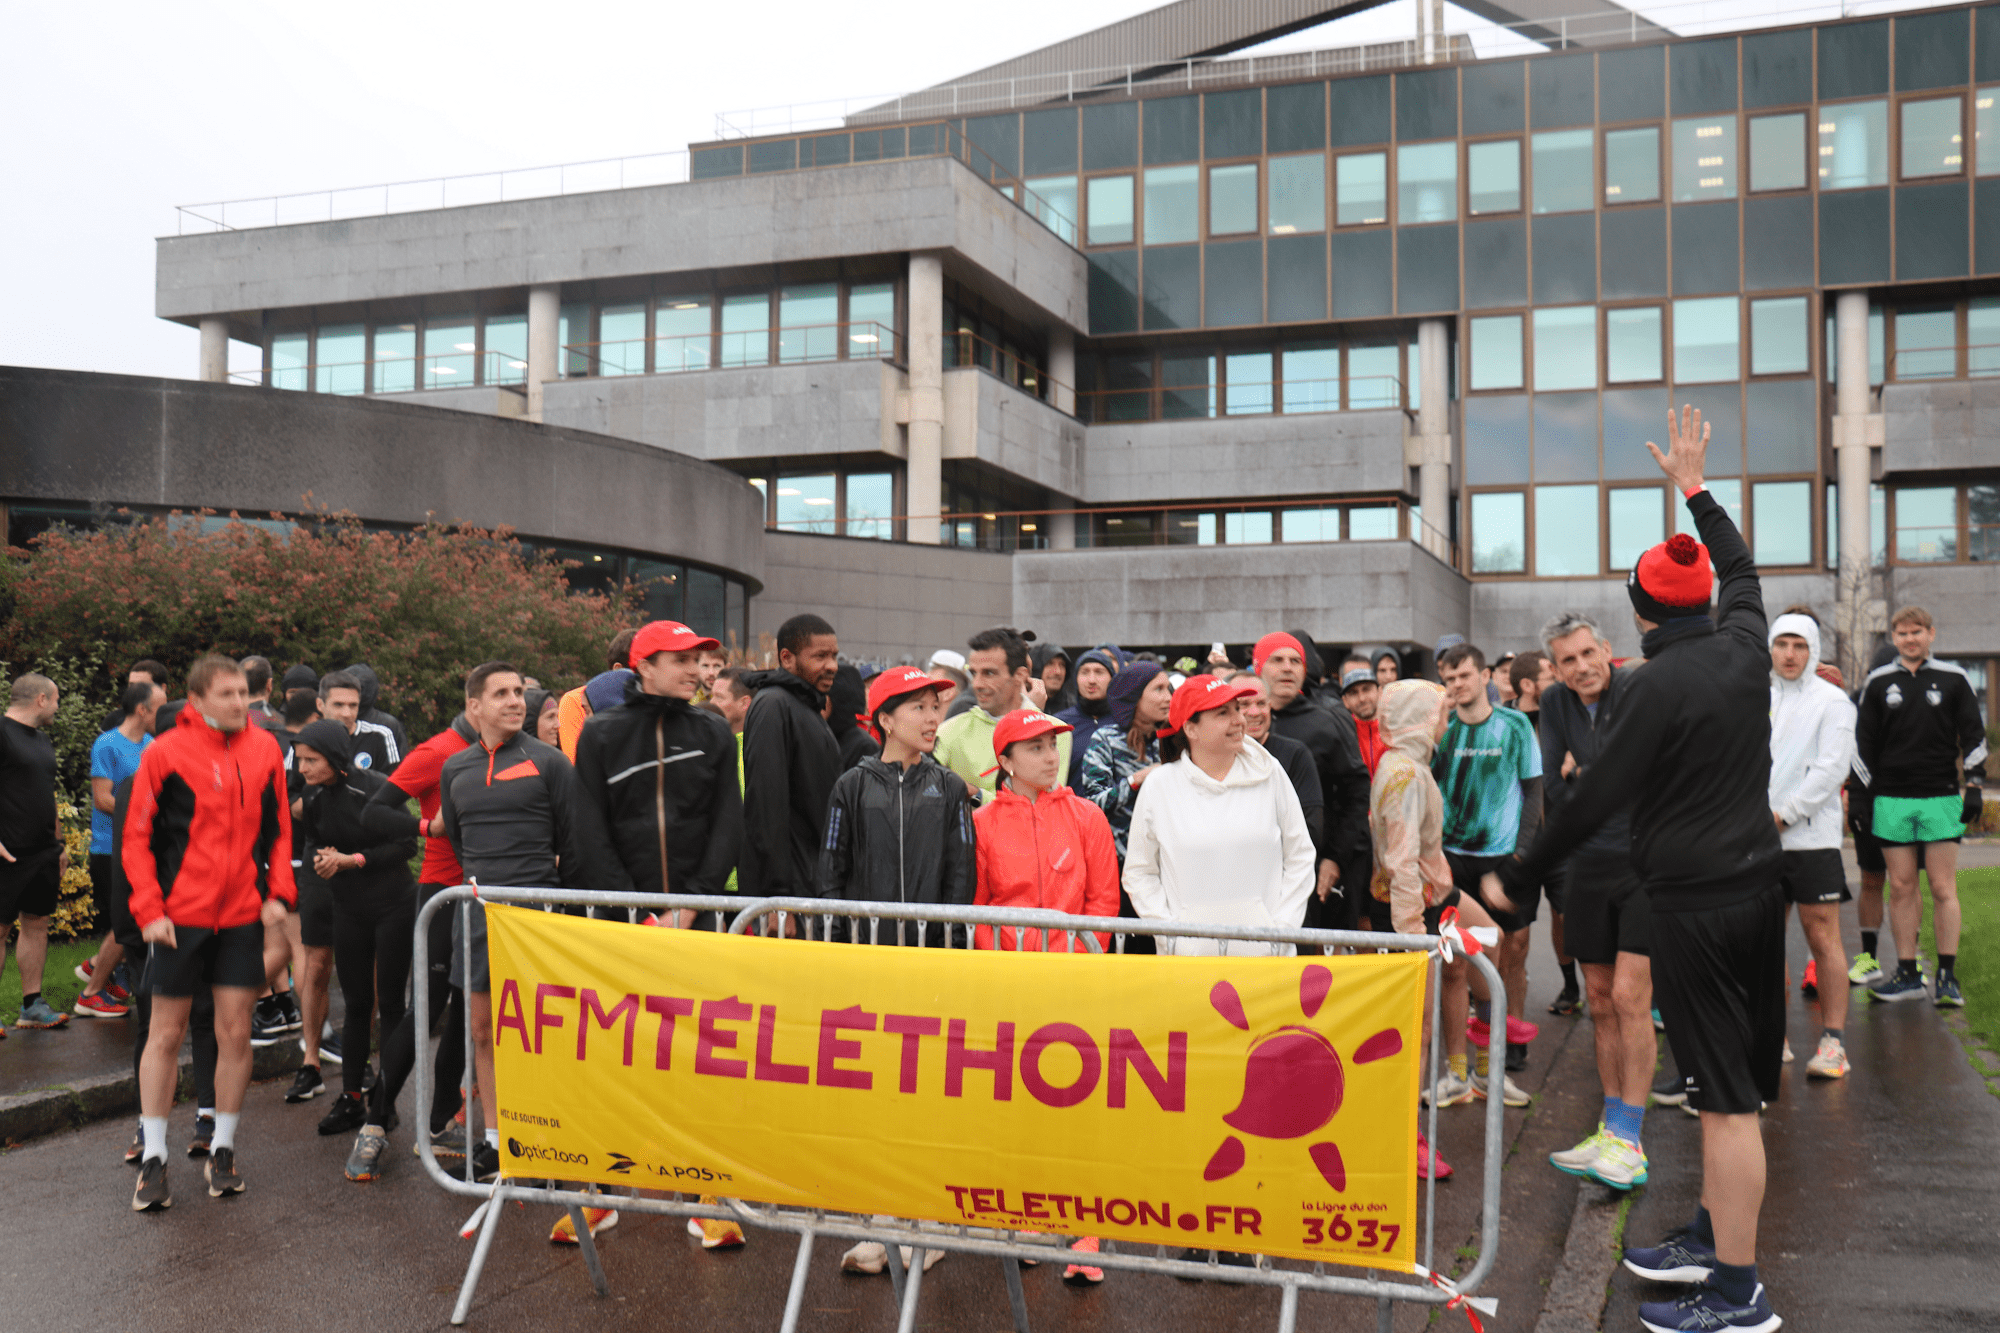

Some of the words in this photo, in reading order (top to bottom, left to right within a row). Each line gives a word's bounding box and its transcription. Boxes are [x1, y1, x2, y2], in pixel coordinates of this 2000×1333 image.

[519, 1112, 549, 1126] SOUTIEN
[1350, 1202, 1364, 1212] du
[1366, 1202, 1388, 1212] don
[1302, 1213, 1401, 1253] 3637
